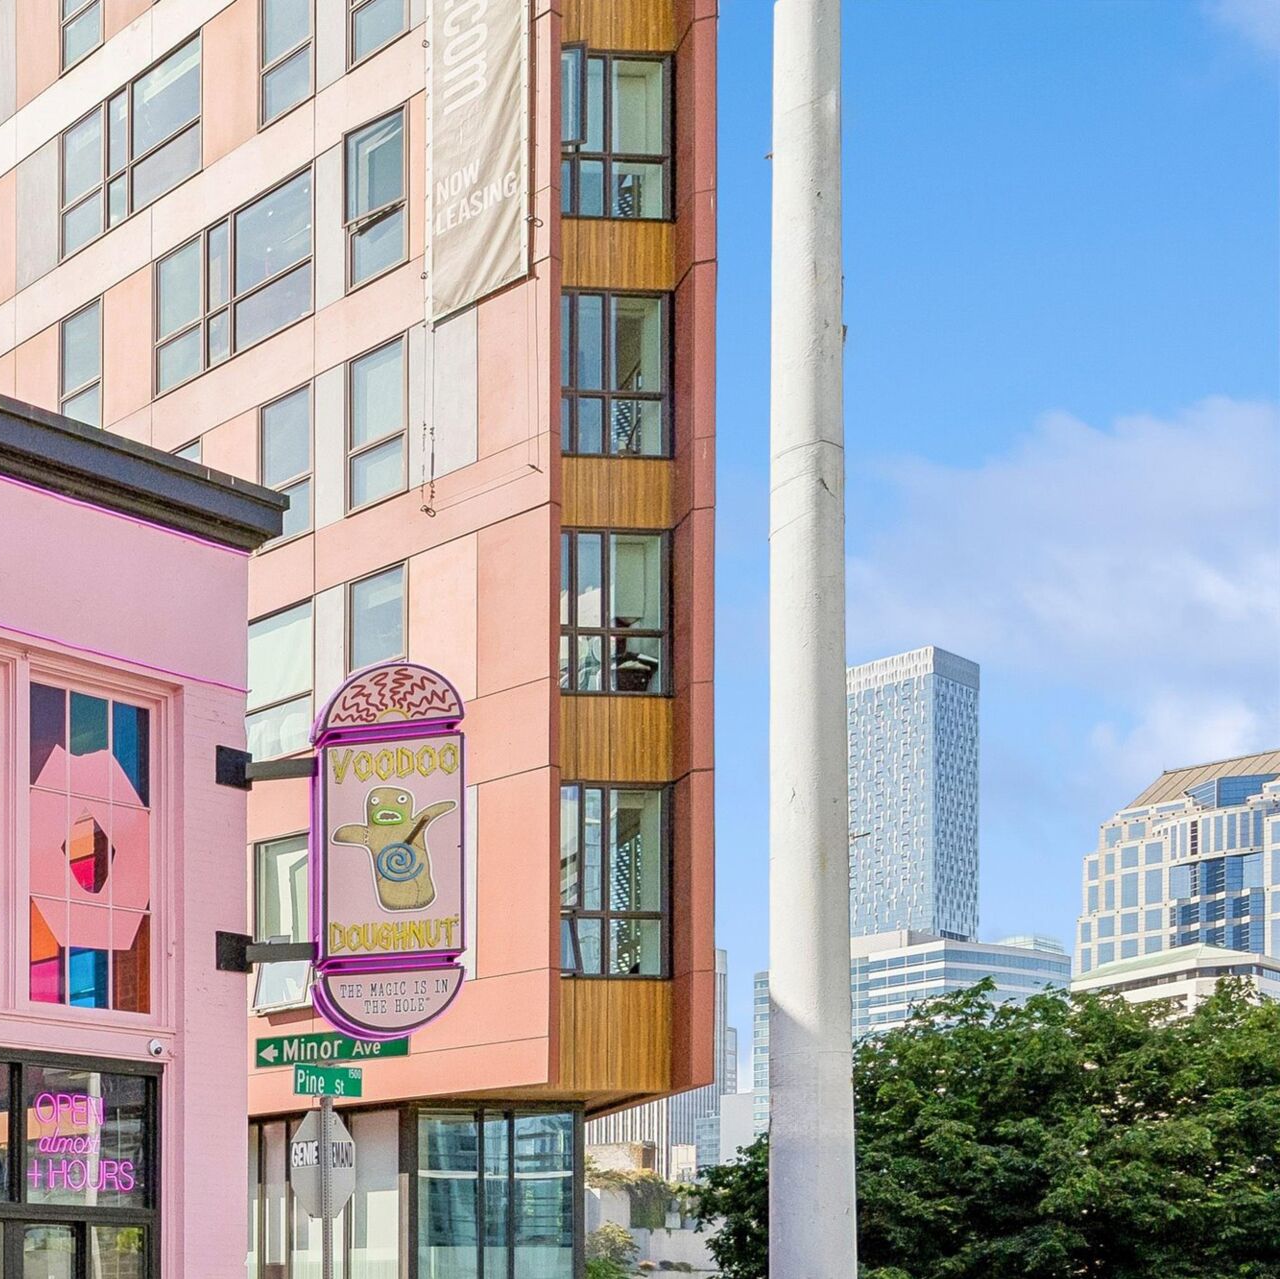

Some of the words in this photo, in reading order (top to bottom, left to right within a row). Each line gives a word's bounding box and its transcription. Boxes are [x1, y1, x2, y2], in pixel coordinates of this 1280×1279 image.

[436, 159, 480, 205] NOW
[436, 170, 517, 235] LEASING
[329, 742, 459, 785] VOODOO
[329, 916, 459, 954] DOUGHNUT
[340, 984, 363, 998] THE
[370, 981, 406, 997] MAGIC
[414, 980, 427, 994] IS
[434, 979, 448, 993] IN
[364, 1000, 387, 1014] THE
[283, 1038, 343, 1062] Minor
[352, 1040, 382, 1056] Ave
[297, 1069, 325, 1093] Pine
[348, 1069, 362, 1079] 1500
[35, 1092, 104, 1127] OPEN
[39, 1126, 101, 1154] almost
[48, 1159, 135, 1191] HOURS
